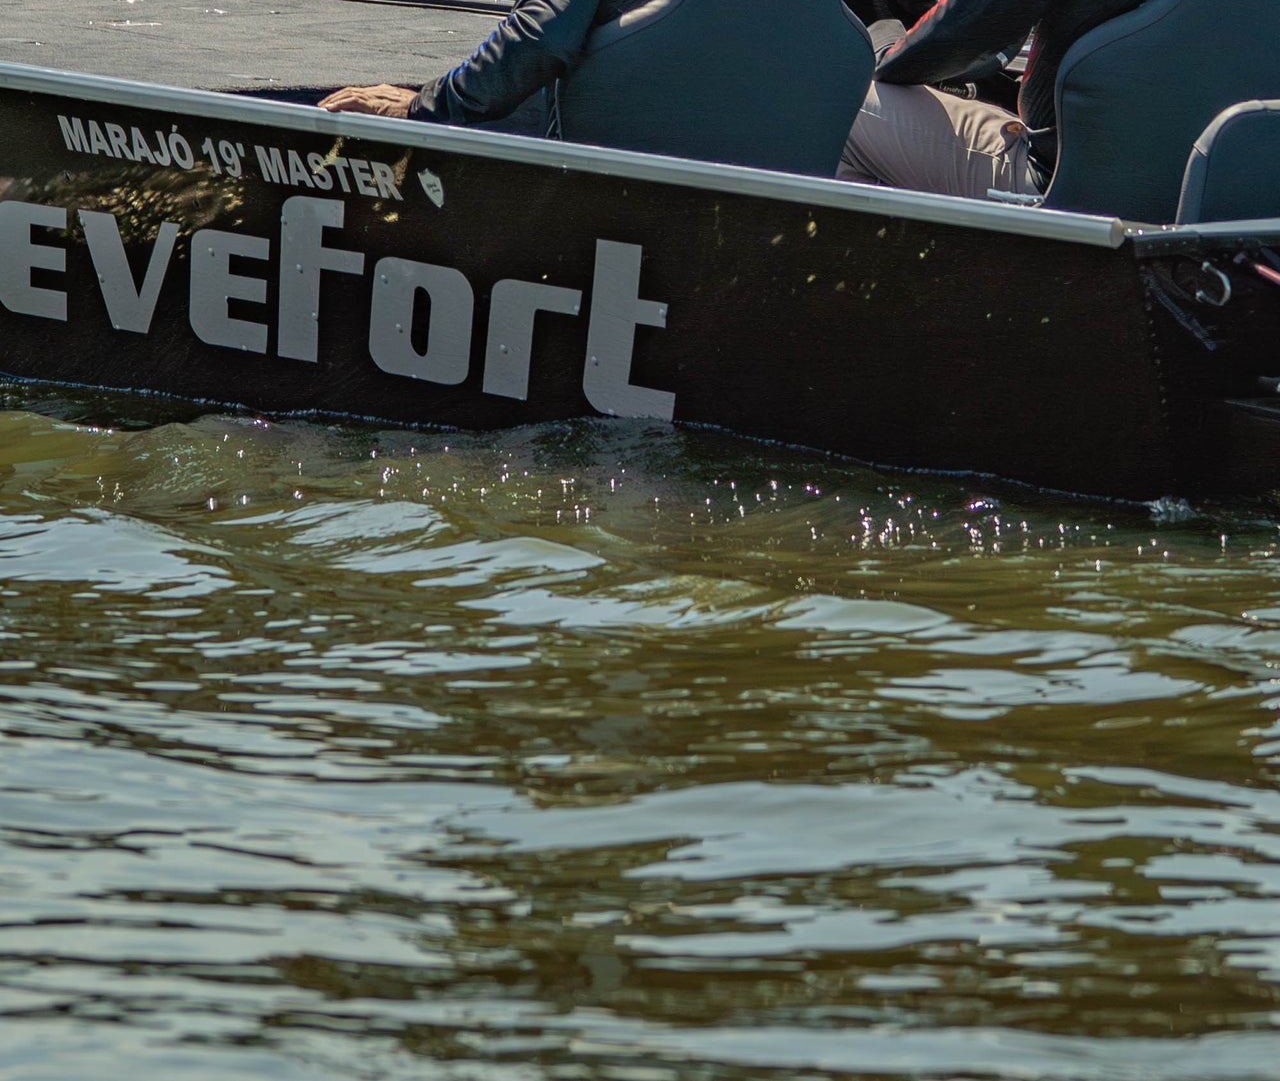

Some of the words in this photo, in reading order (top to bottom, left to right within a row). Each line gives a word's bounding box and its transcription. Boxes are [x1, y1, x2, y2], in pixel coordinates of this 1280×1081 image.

[57, 114, 195, 170] MARAJÓ
[201, 136, 245, 178] 19'
[254, 145, 404, 201] MASTER
